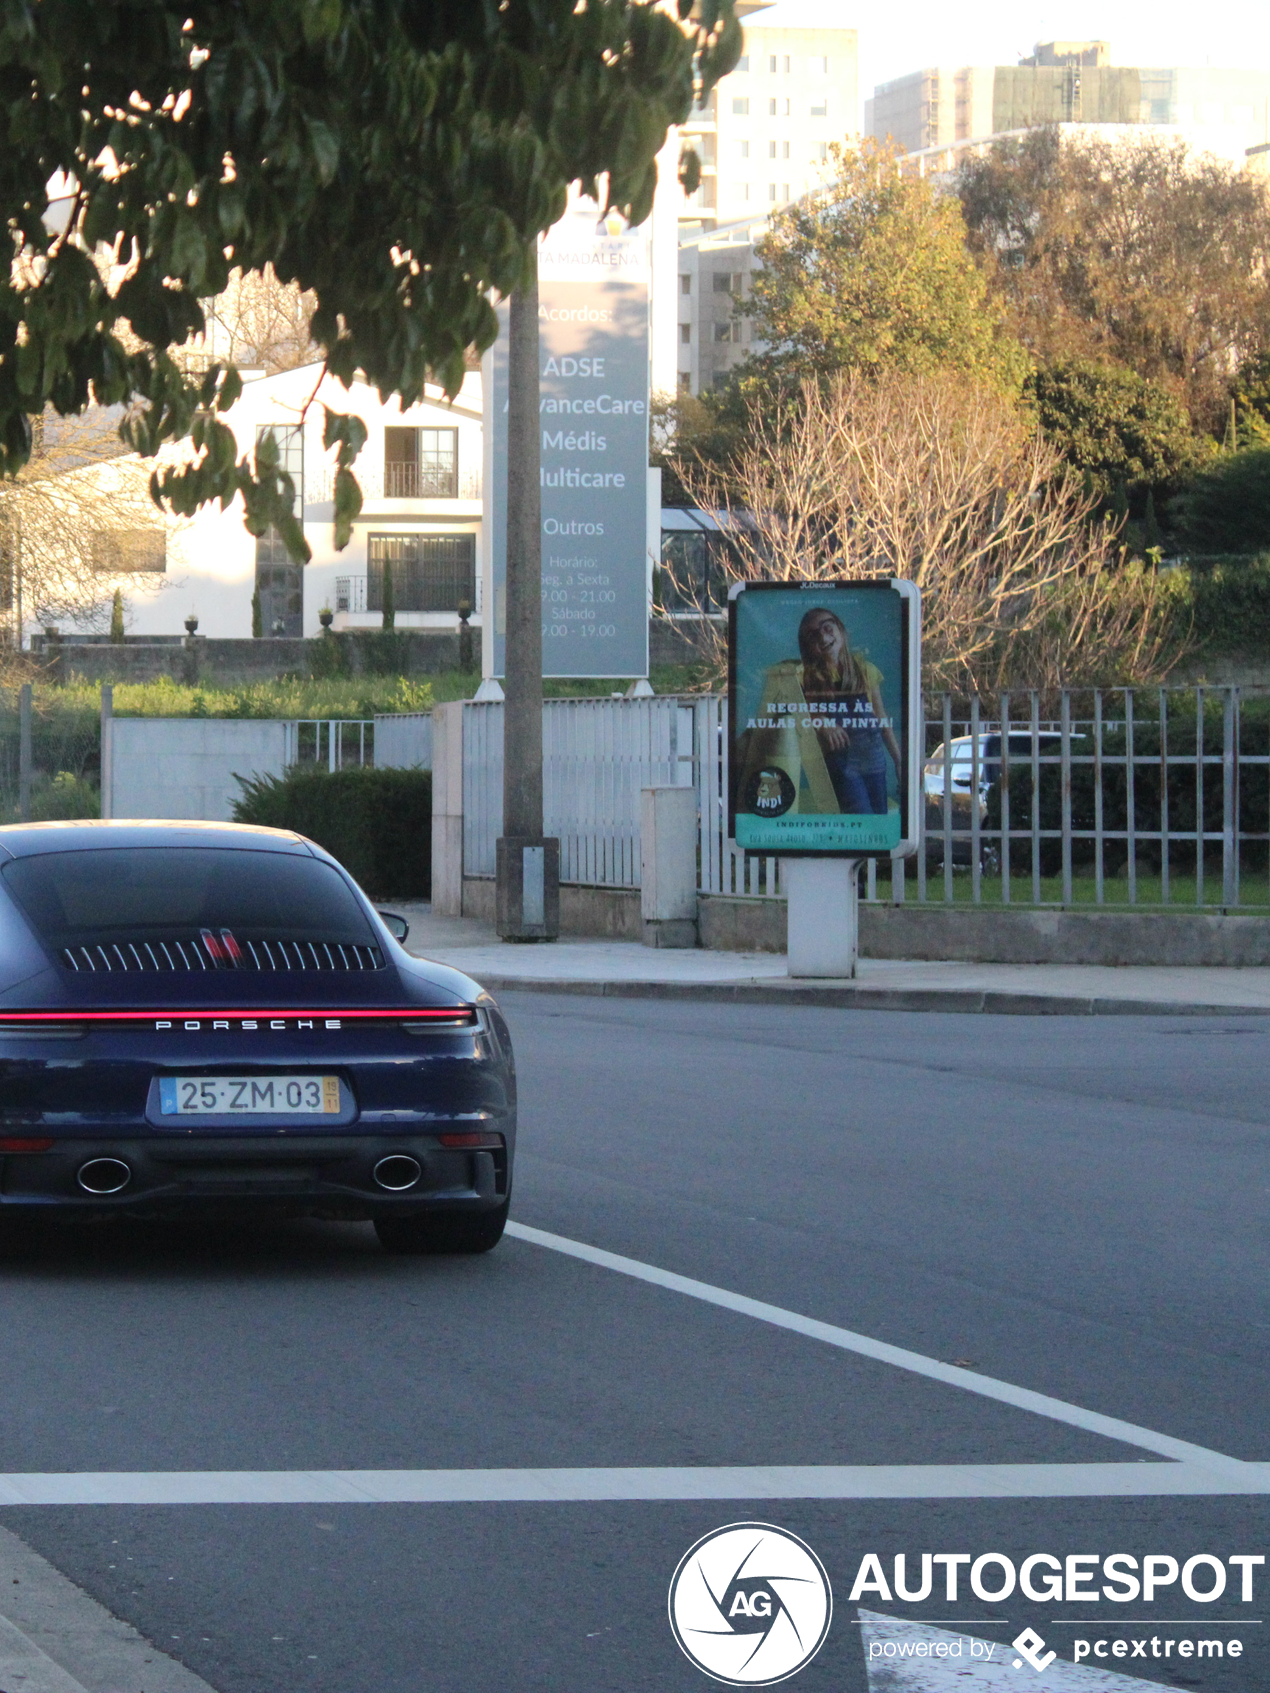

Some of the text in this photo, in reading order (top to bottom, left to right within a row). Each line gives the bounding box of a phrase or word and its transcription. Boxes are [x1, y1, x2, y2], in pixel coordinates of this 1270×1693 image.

[558, 252, 639, 265] MADALENA
[538, 304, 613, 322] Acordos:
[543, 357, 605, 377] ADSE
[543, 430, 607, 451] Médis
[543, 518, 605, 536] Outros
[549, 556, 598, 569] Horário:
[566, 576, 573, 586] a
[577, 573, 610, 586] Sexta
[580, 590, 616, 603] 21.00
[552, 607, 596, 620] Sábado
[580, 624, 616, 637] 19.00
[767, 699, 874, 713] REGRESSA ÀS
[746, 717, 894, 728] AULAS COM PINTA!
[757, 794, 782, 809] INDI
[155, 1020, 342, 1031] PORSCHE
